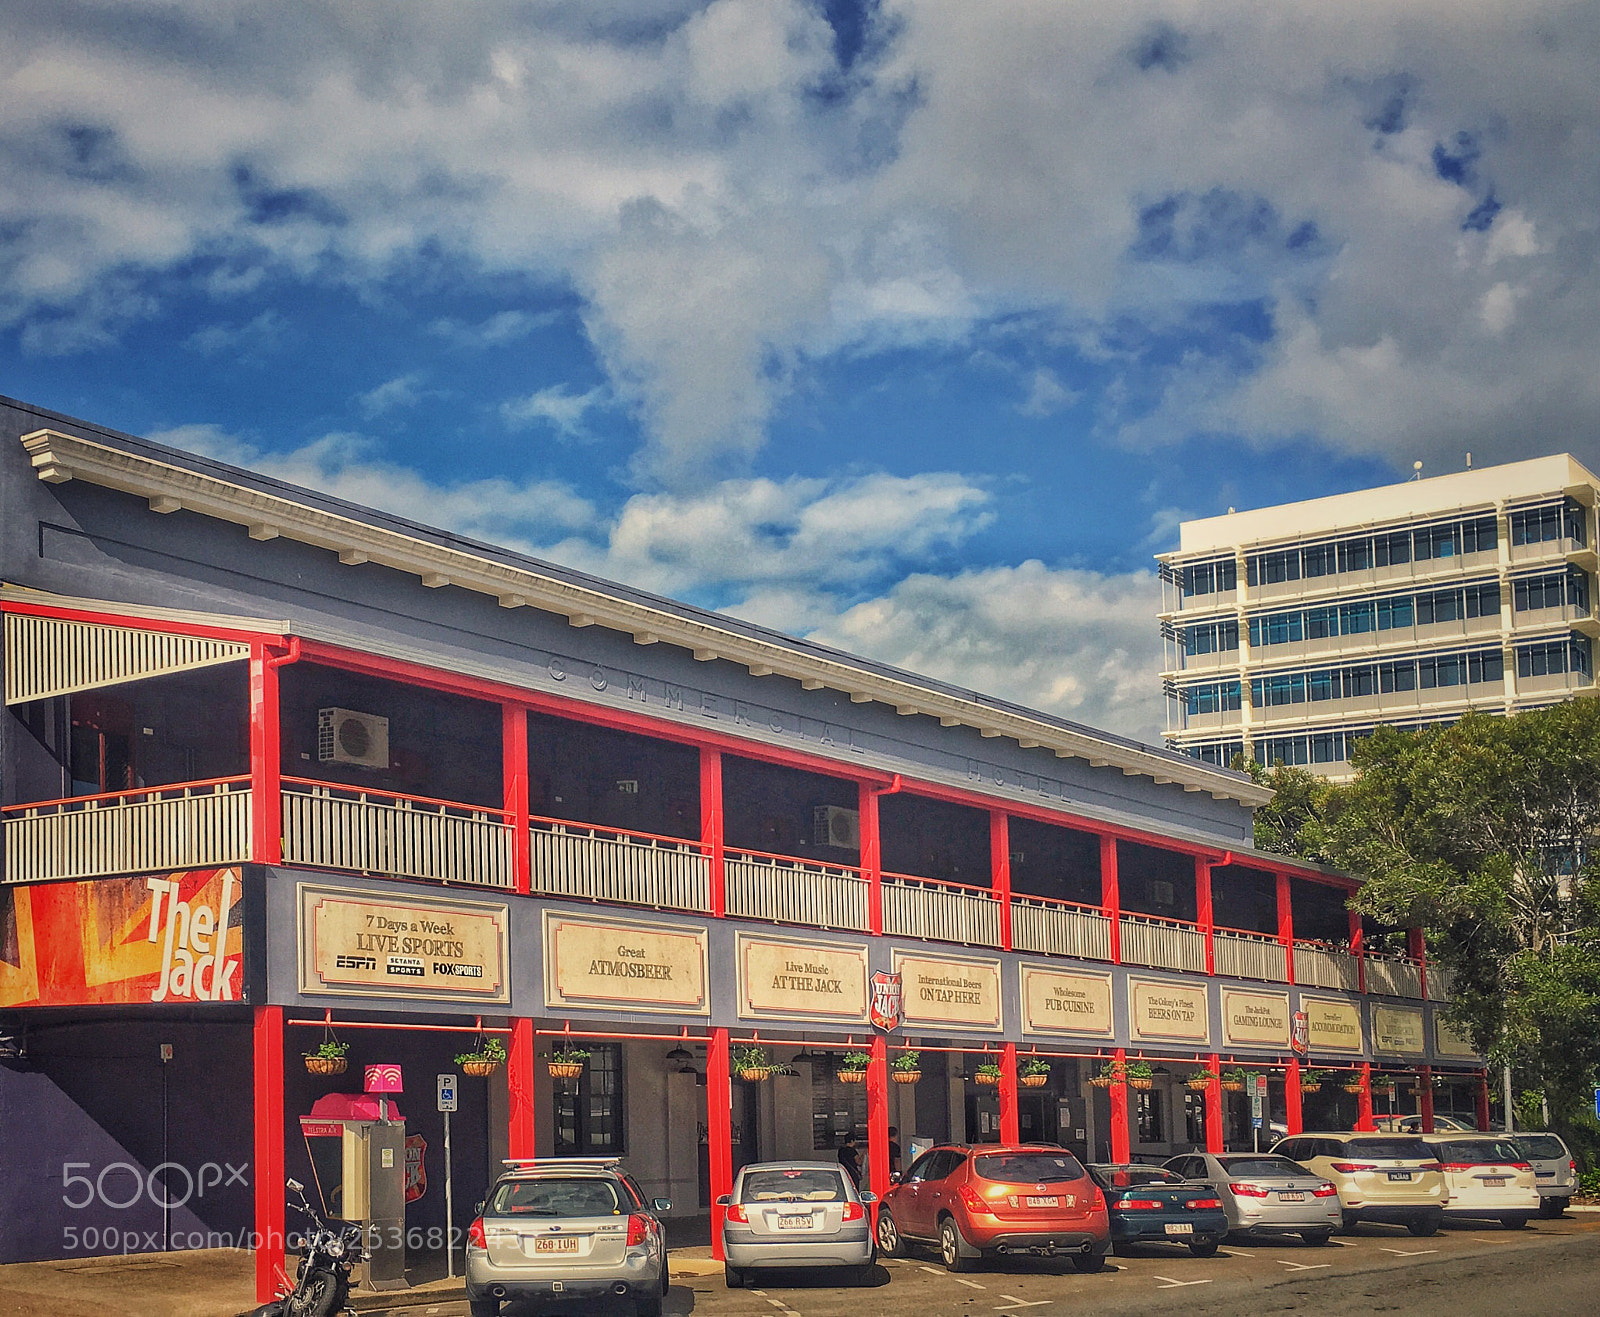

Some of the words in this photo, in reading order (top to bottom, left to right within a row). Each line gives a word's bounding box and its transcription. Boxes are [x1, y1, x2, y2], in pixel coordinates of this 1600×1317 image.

[548, 655, 865, 755] COMMERCIAL
[966, 758, 1072, 804] HOTEL
[147, 877, 214, 953] The
[366, 914, 375, 928] 7
[377, 916, 408, 933] Days
[410, 922, 418, 932] a
[419, 920, 456, 936] Week
[151, 869, 238, 1003] Jack
[356, 932, 399, 953] LIVE
[402, 936, 464, 958] SPORTS
[617, 945, 646, 959] Great
[336, 955, 376, 970] ESPN
[390, 958, 421, 966] SETANTA
[785, 961, 804, 973] Live
[805, 963, 829, 975] Music
[390, 967, 422, 975] SPORTS
[433, 963, 455, 975] FOX
[455, 966, 482, 977] SPORTS
[588, 960, 673, 981] ATMOSBEER
[772, 975, 790, 989] AT
[790, 976, 813, 991] THE
[814, 978, 843, 994] JACK
[918, 974, 963, 988] International
[963, 978, 982, 989] Beers
[875, 983, 900, 996] UNION
[920, 988, 935, 1001] ON
[935, 989, 955, 1003] TAP
[955, 990, 981, 1005] HERE
[1053, 986, 1086, 999] Wholesome
[875, 995, 899, 1018] JACK
[1045, 998, 1062, 1011] PUB
[1062, 1000, 1095, 1014] CUISINE
[1148, 996, 1158, 1005] The
[1148, 1008, 1171, 1020] BEERS
[1171, 1009, 1181, 1021] ON
[1181, 1010, 1195, 1022] TAP
[1233, 1014, 1259, 1027] GAMING
[1259, 1016, 1283, 1029] LOUNGE
[443, 1077, 451, 1087] P
